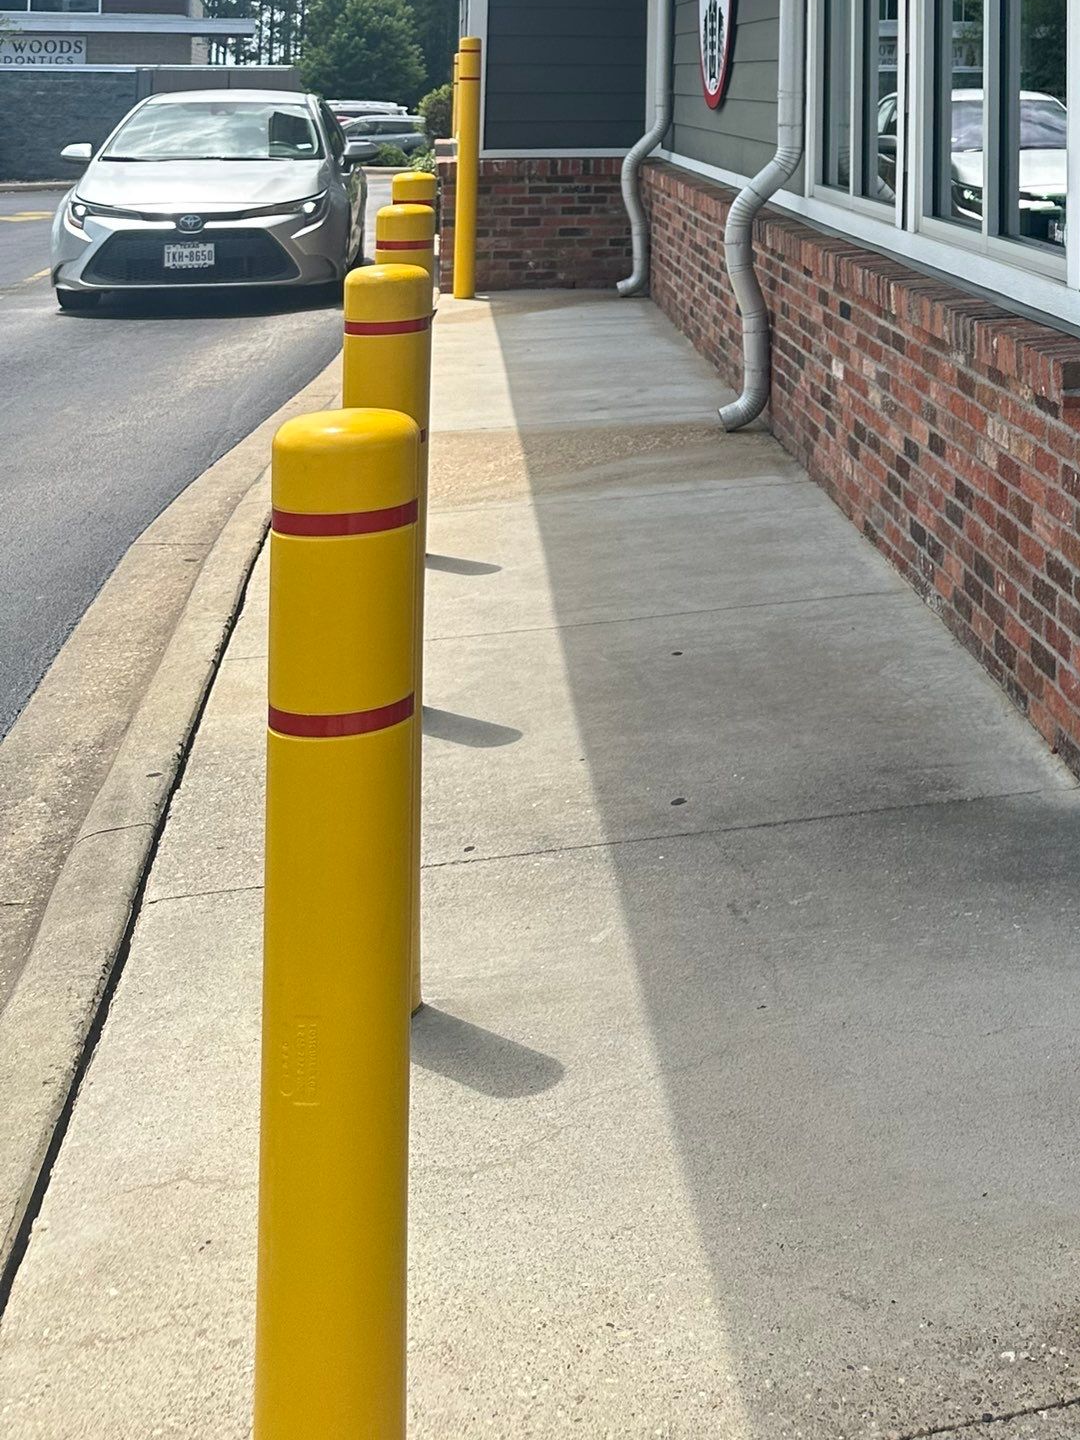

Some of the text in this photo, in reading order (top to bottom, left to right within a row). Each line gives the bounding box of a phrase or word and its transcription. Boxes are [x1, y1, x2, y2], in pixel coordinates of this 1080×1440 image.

[12, 39, 83, 54] WOODS
[1, 55, 74, 65] DONTICS
[166, 249, 213, 263] TKH-8650
